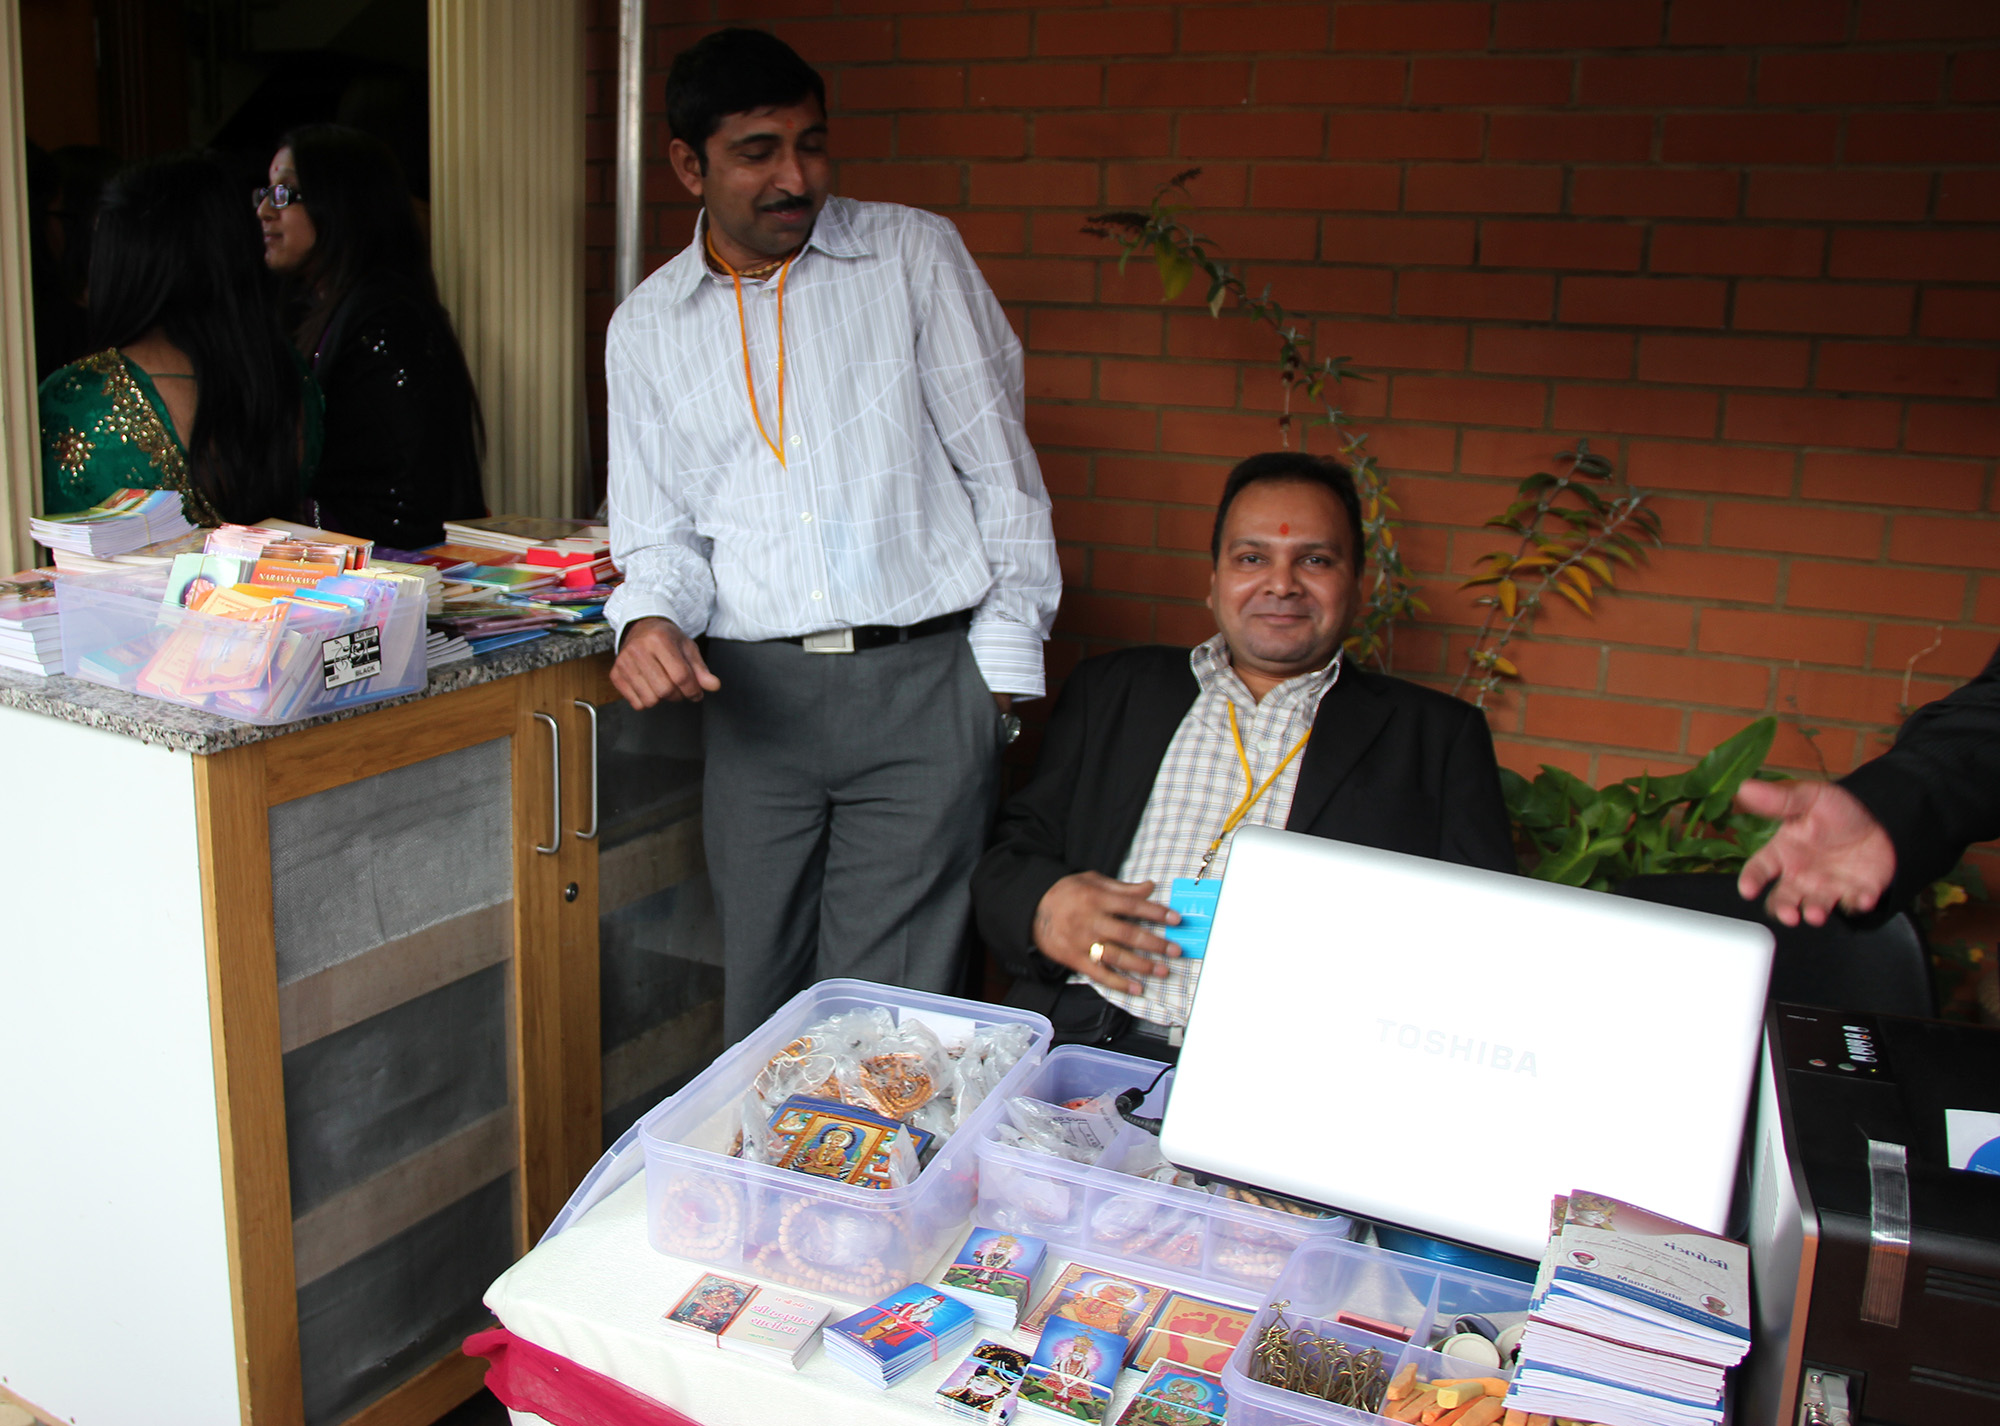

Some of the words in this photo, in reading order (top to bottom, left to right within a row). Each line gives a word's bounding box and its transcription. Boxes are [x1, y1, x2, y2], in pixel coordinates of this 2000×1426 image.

[355, 665, 375, 676] BLACK
[1376, 1018, 1537, 1077] TOSHIBA
[1617, 1274, 1682, 1301] Mantrapothi
